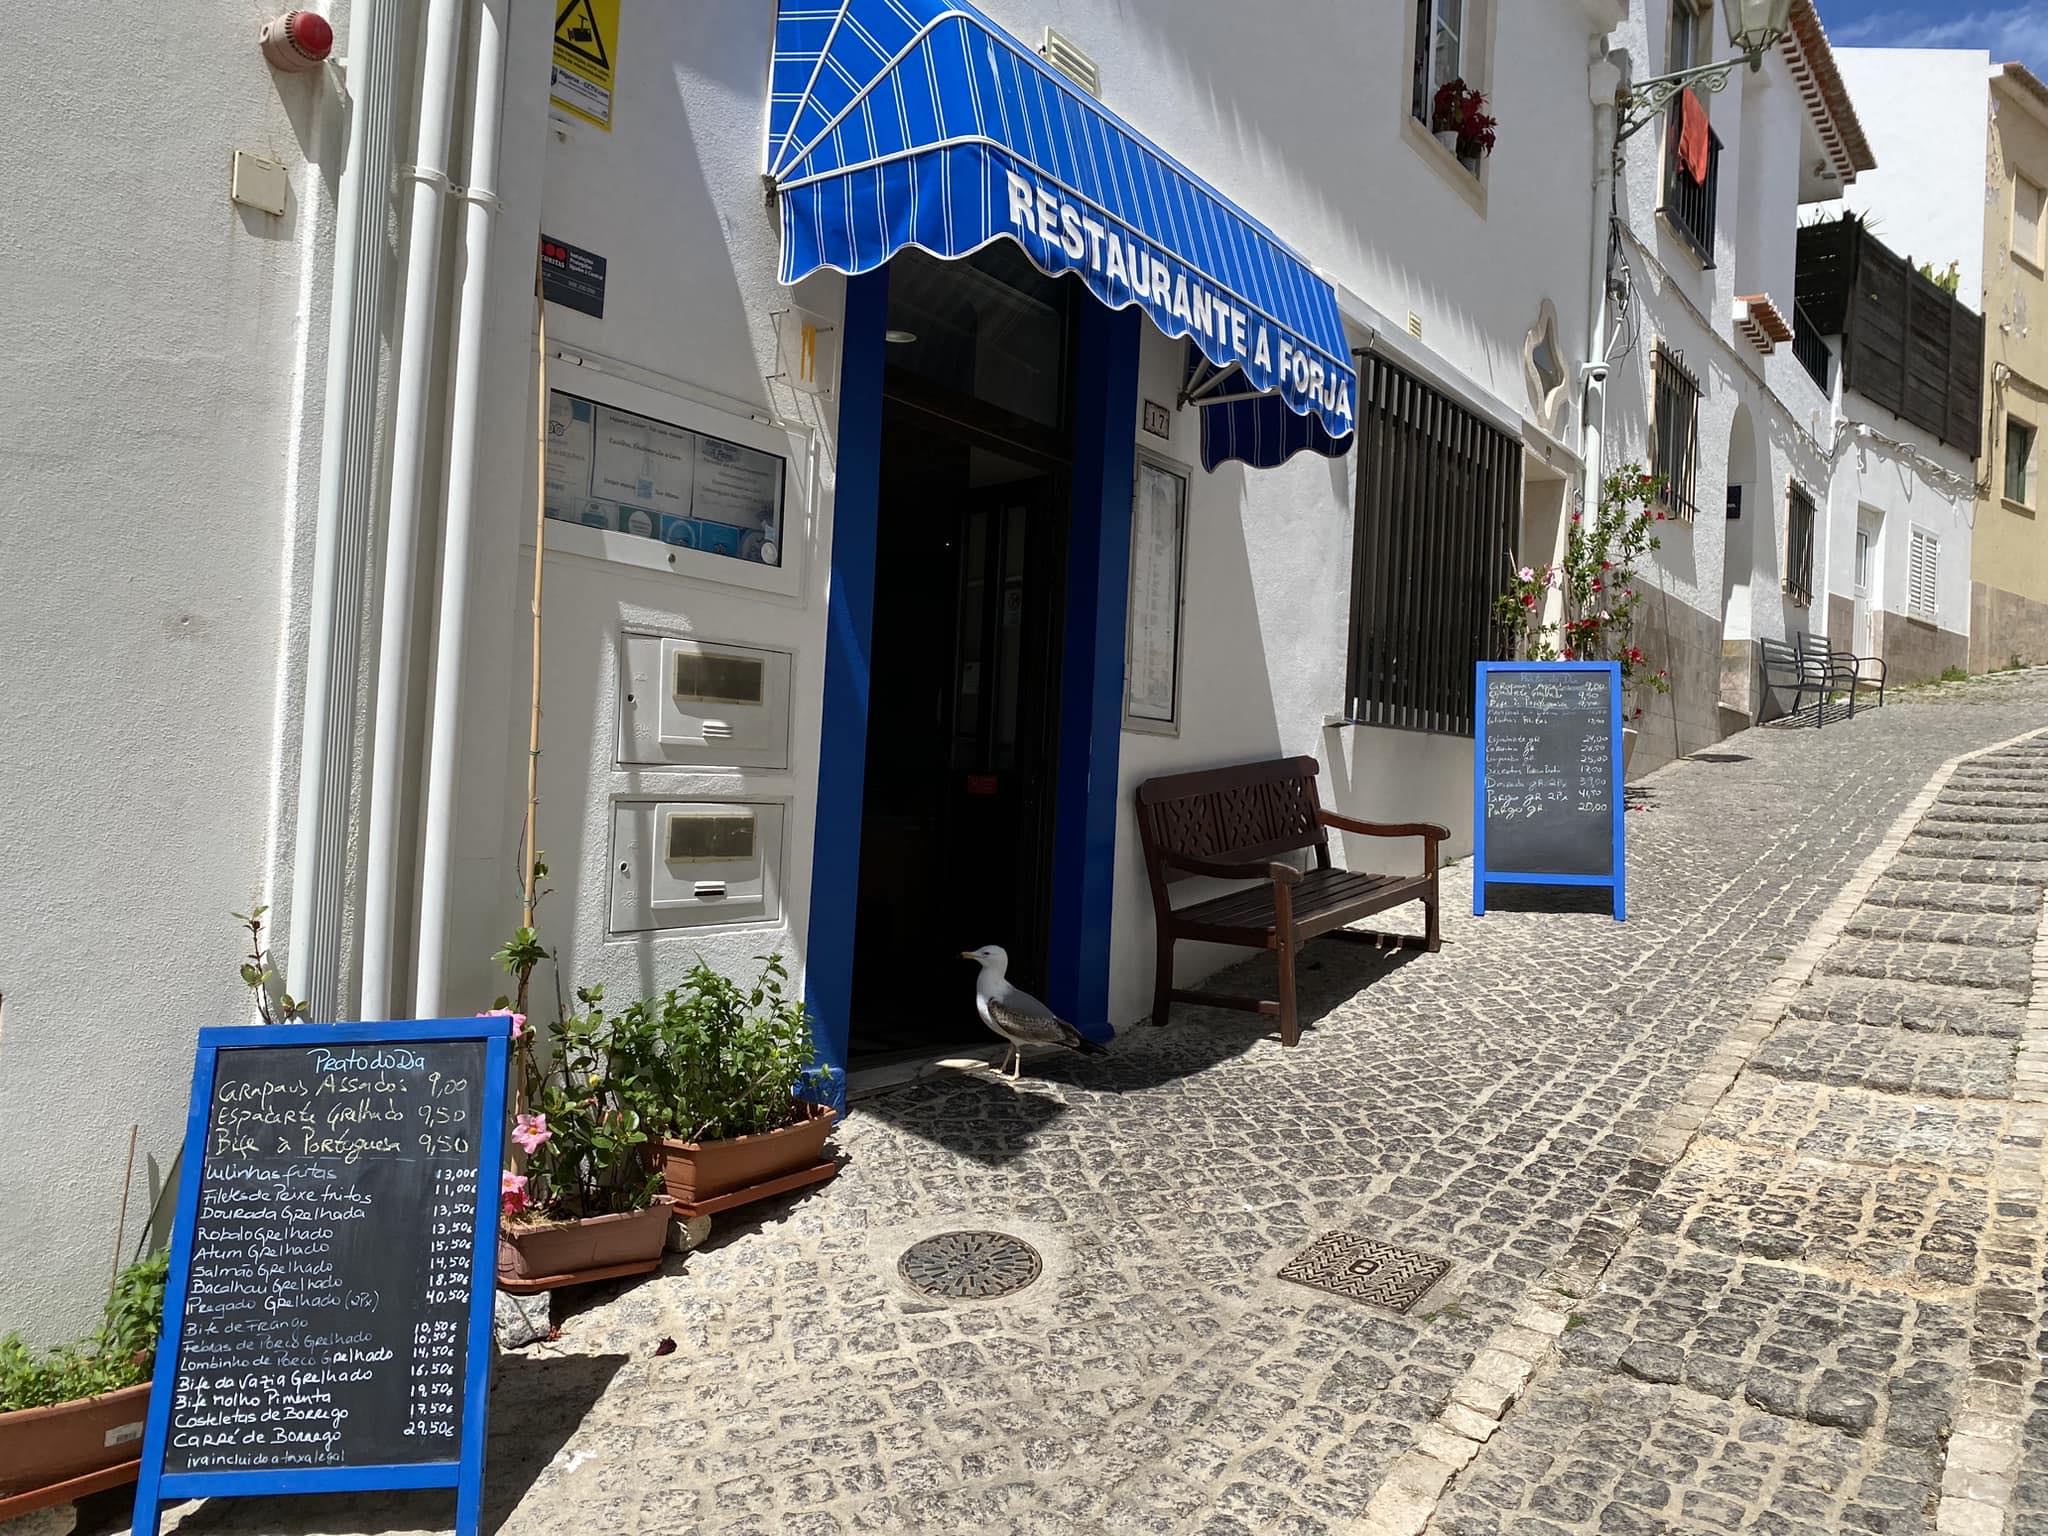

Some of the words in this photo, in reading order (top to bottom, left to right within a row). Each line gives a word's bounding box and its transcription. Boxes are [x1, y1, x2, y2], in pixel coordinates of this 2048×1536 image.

[1006, 169, 1249, 357] RESTAURANTE
[1254, 325, 1273, 374] A
[1278, 340, 1353, 421] FORJA
[1152, 412, 1164, 429] 17
[428, 1071, 468, 1098] 9,00
[418, 1105, 466, 1128] 9,50
[418, 1133, 469, 1156] 9,50
[224, 1322, 246, 1333] de
[236, 1338, 256, 1351] de
[252, 1355, 273, 1367] de
[214, 1376, 235, 1389] da
[260, 1407, 282, 1421] de
[242, 1428, 266, 1444] de
